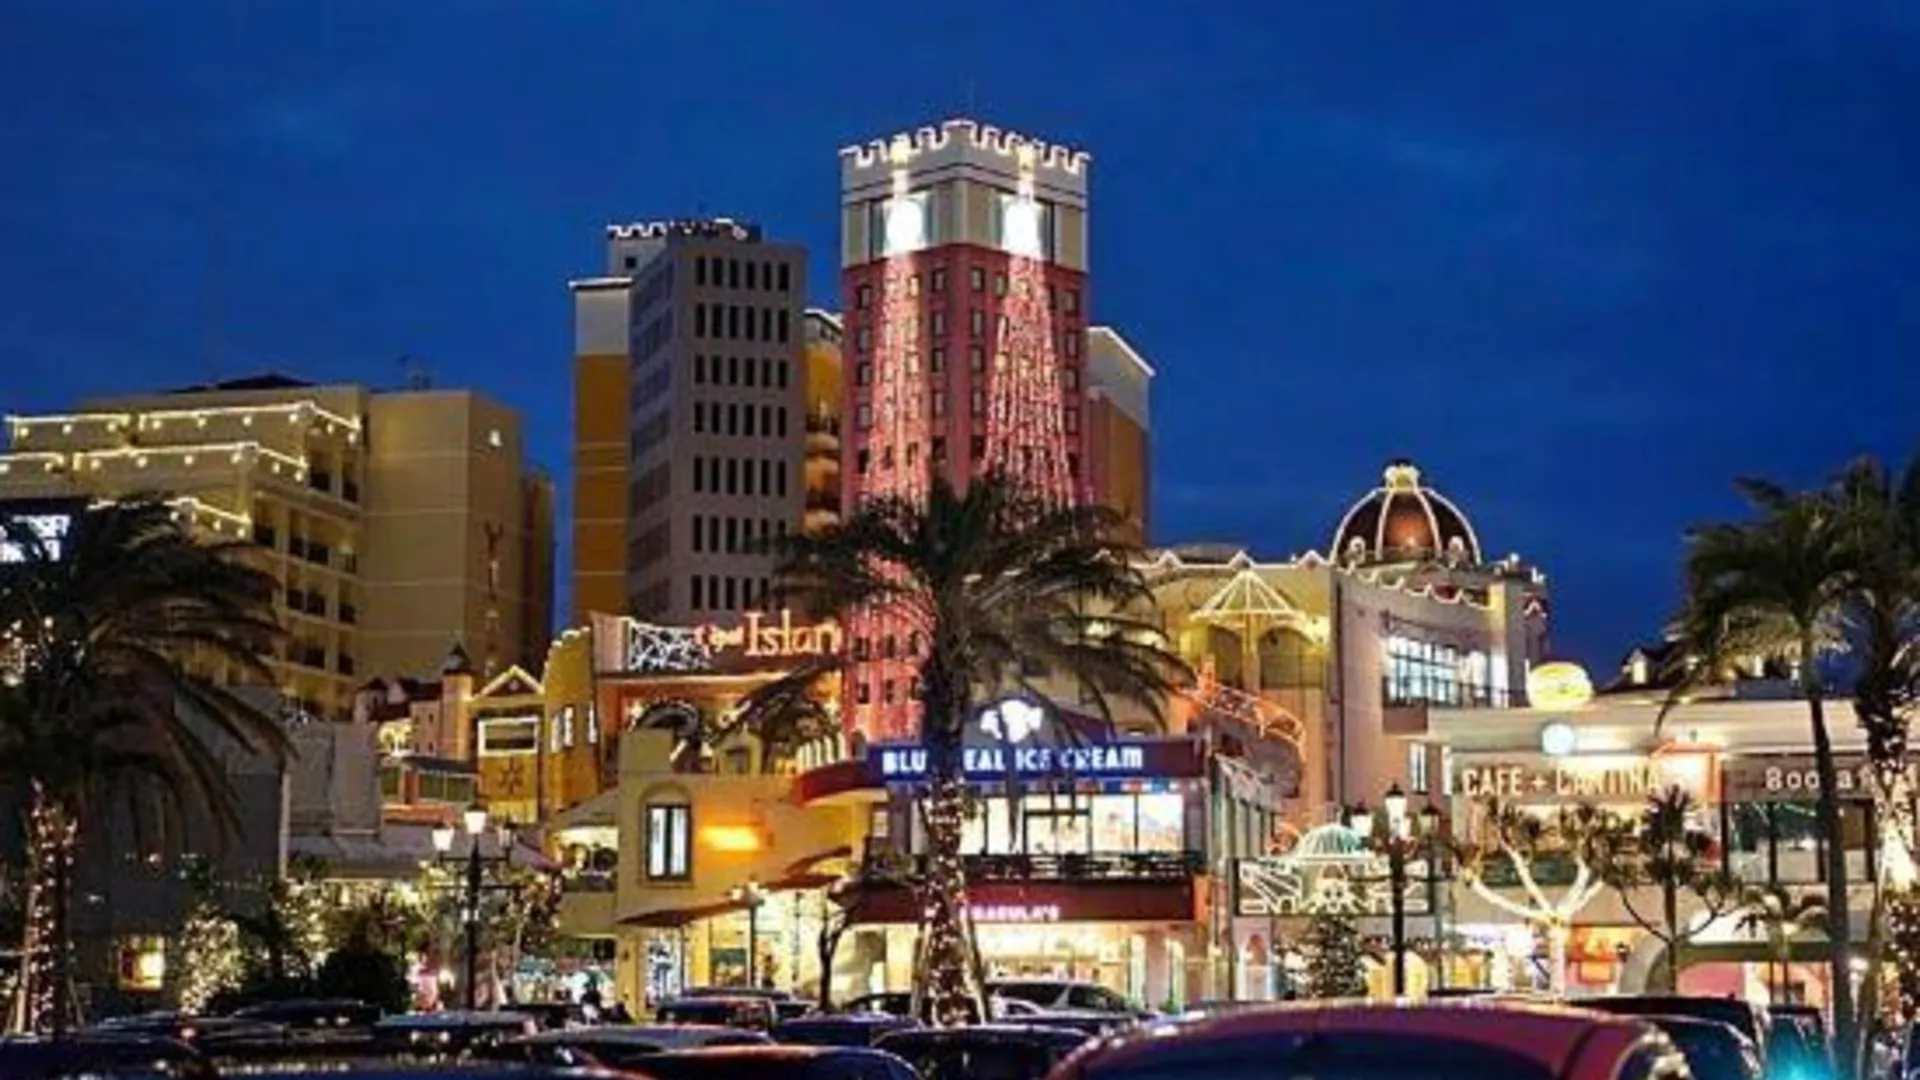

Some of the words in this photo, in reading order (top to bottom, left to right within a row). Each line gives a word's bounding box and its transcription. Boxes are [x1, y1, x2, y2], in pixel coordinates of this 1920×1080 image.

[882, 751, 927, 773] BLU
[963, 749, 1005, 772] EAL
[1462, 768, 1524, 797] CAFE
